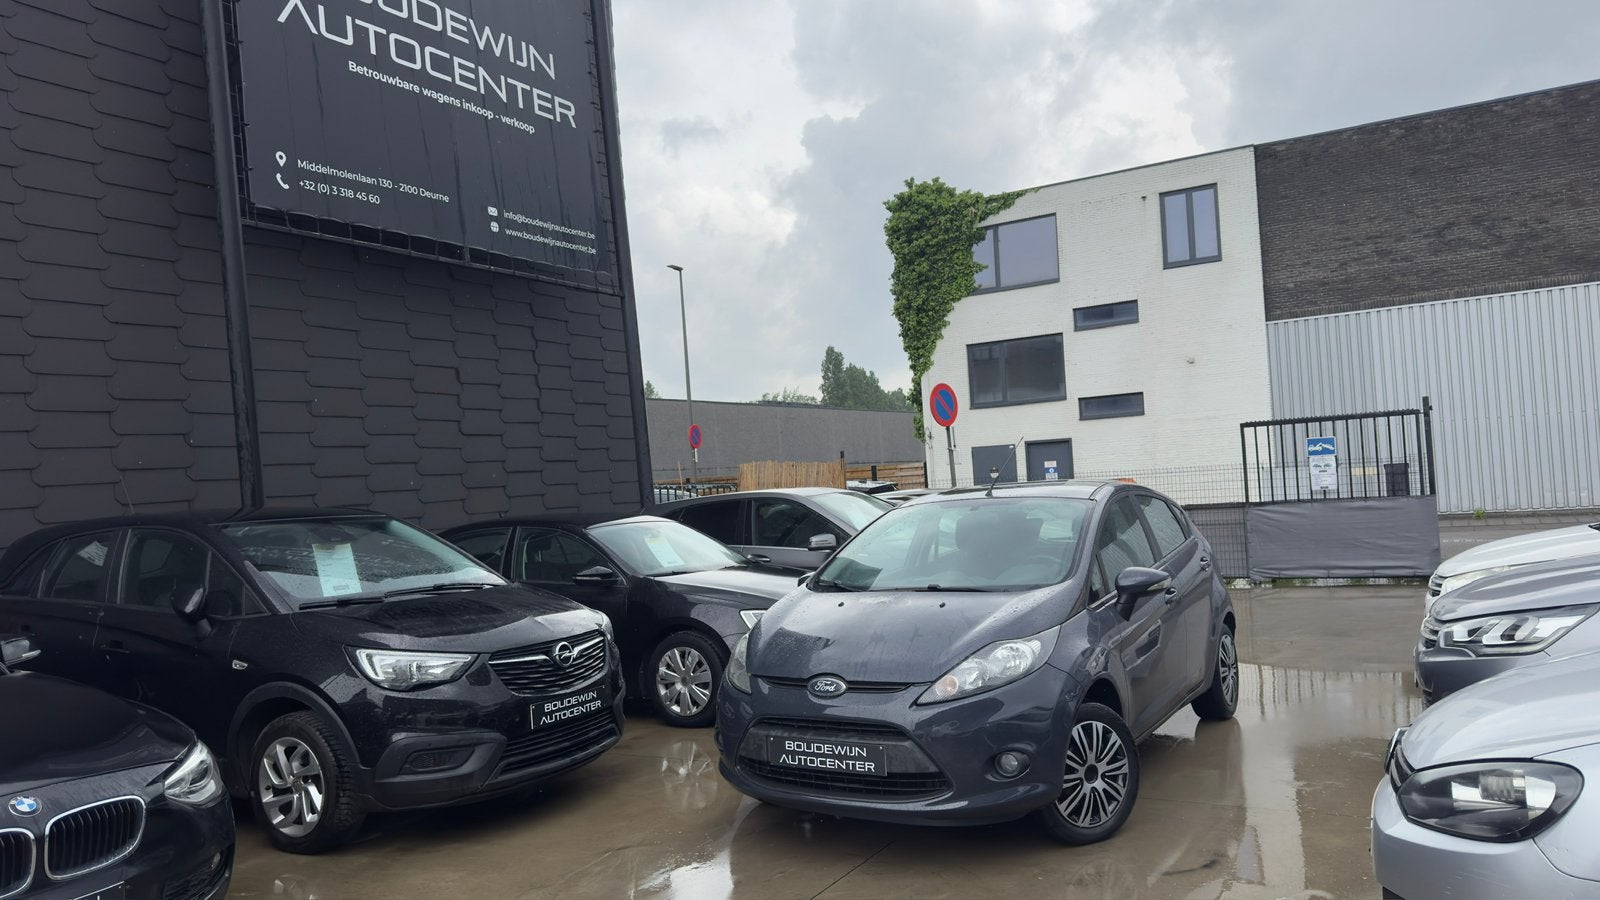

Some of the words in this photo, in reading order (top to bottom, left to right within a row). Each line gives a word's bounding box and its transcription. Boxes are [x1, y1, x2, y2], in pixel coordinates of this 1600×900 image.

[361, 0, 555, 80] DEWIJN
[277, 0, 576, 128] AUTOCENTER
[348, 60, 420, 94] Betrouwbare
[422, 87, 461, 107] wagens
[462, 99, 494, 120] inkoop
[500, 114, 535, 134] verkoop
[297, 159, 377, 186] Middelmolenlaan
[378, 177, 393, 189] 130
[399, 183, 419, 195] 2100
[419, 188, 450, 203] Deurne
[299, 180, 316, 191] +32
[317, 183, 330, 195] (0)
[331, 185, 338, 195] 3
[339, 187, 355, 199] 318
[355, 191, 368, 201] 45
[368, 194, 381, 205] 60
[503, 210, 596, 240] info@boudewijnautocenter.be
[504, 228, 597, 255] www.boudewijnautocenter.be
[814, 680, 837, 692] Ford
[540, 700, 602, 725] AUTOCENTER
[544, 690, 597, 713] BOUDEWIJN
[785, 740, 867, 757] BOUDEWIJN
[779, 754, 875, 772] AUTOCENTER
